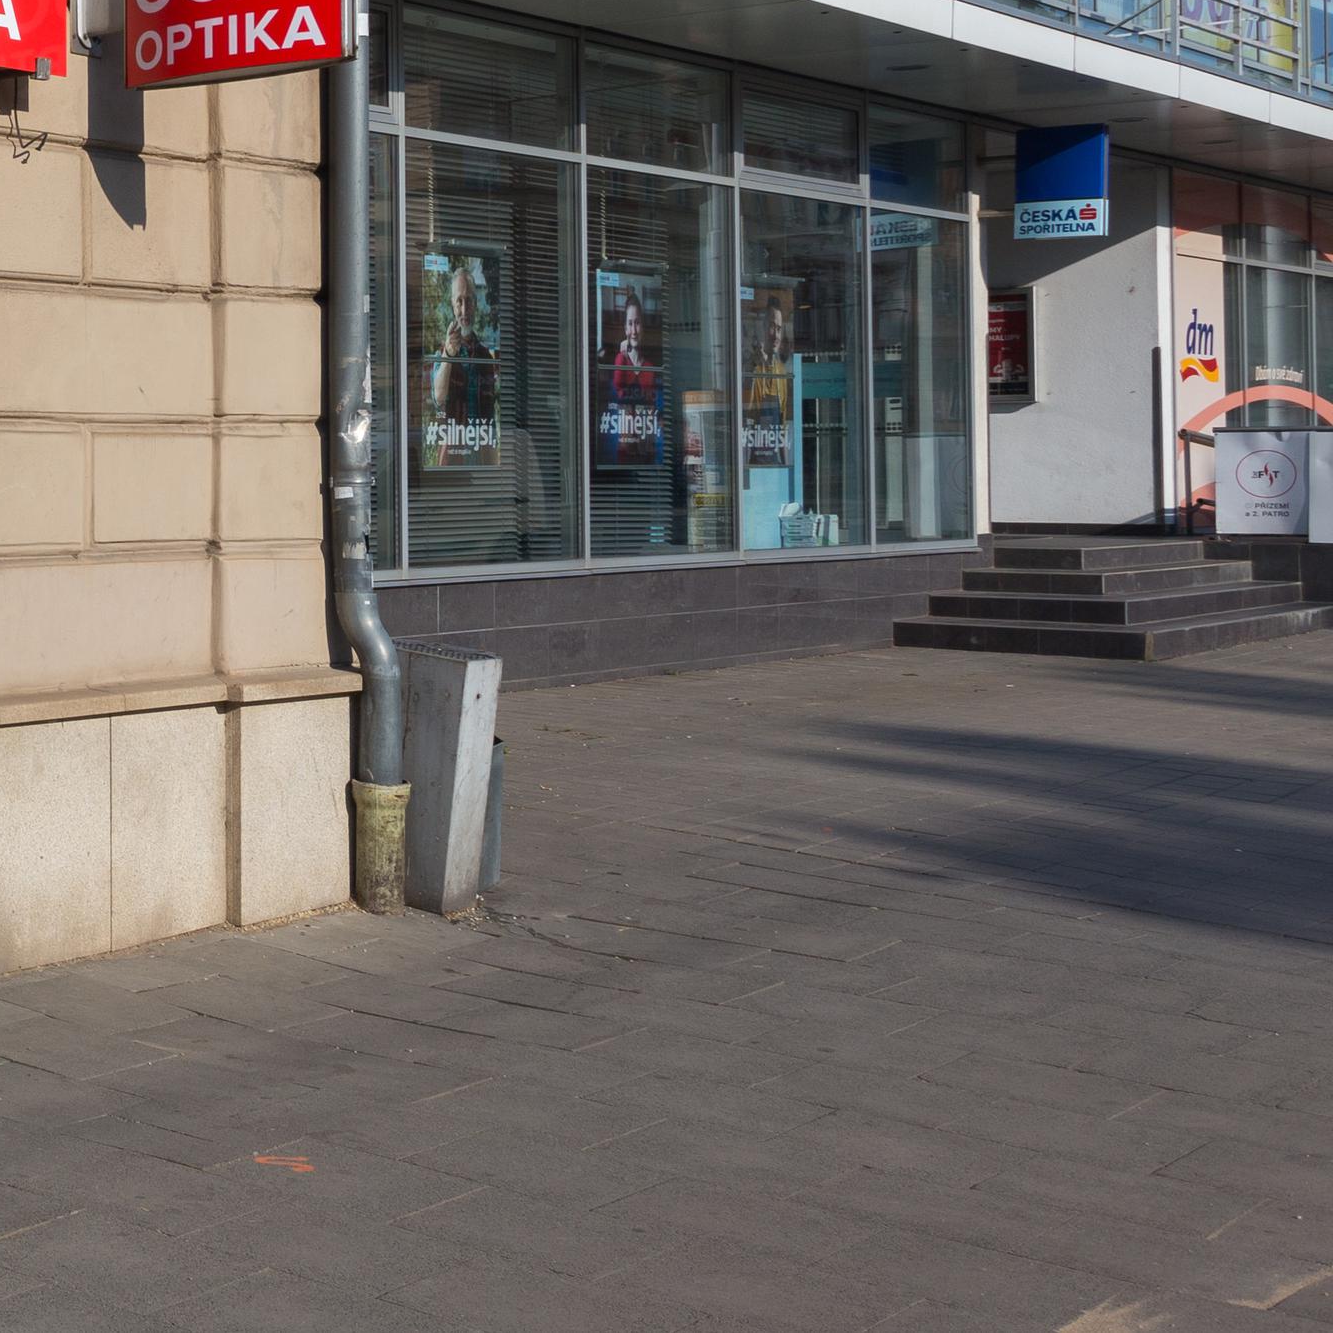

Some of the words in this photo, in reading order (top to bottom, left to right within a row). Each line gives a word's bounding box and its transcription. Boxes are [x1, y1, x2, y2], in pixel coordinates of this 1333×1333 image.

[134, 5, 327, 71] OPTIKA
[1018, 222, 1096, 235] SPOŘITELNA
[1020, 205, 1078, 224] ČESKÁ
[1186, 308, 1214, 356] dm
[425, 417, 497, 452] #silnější,
[599, 408, 662, 440] #silnější,
